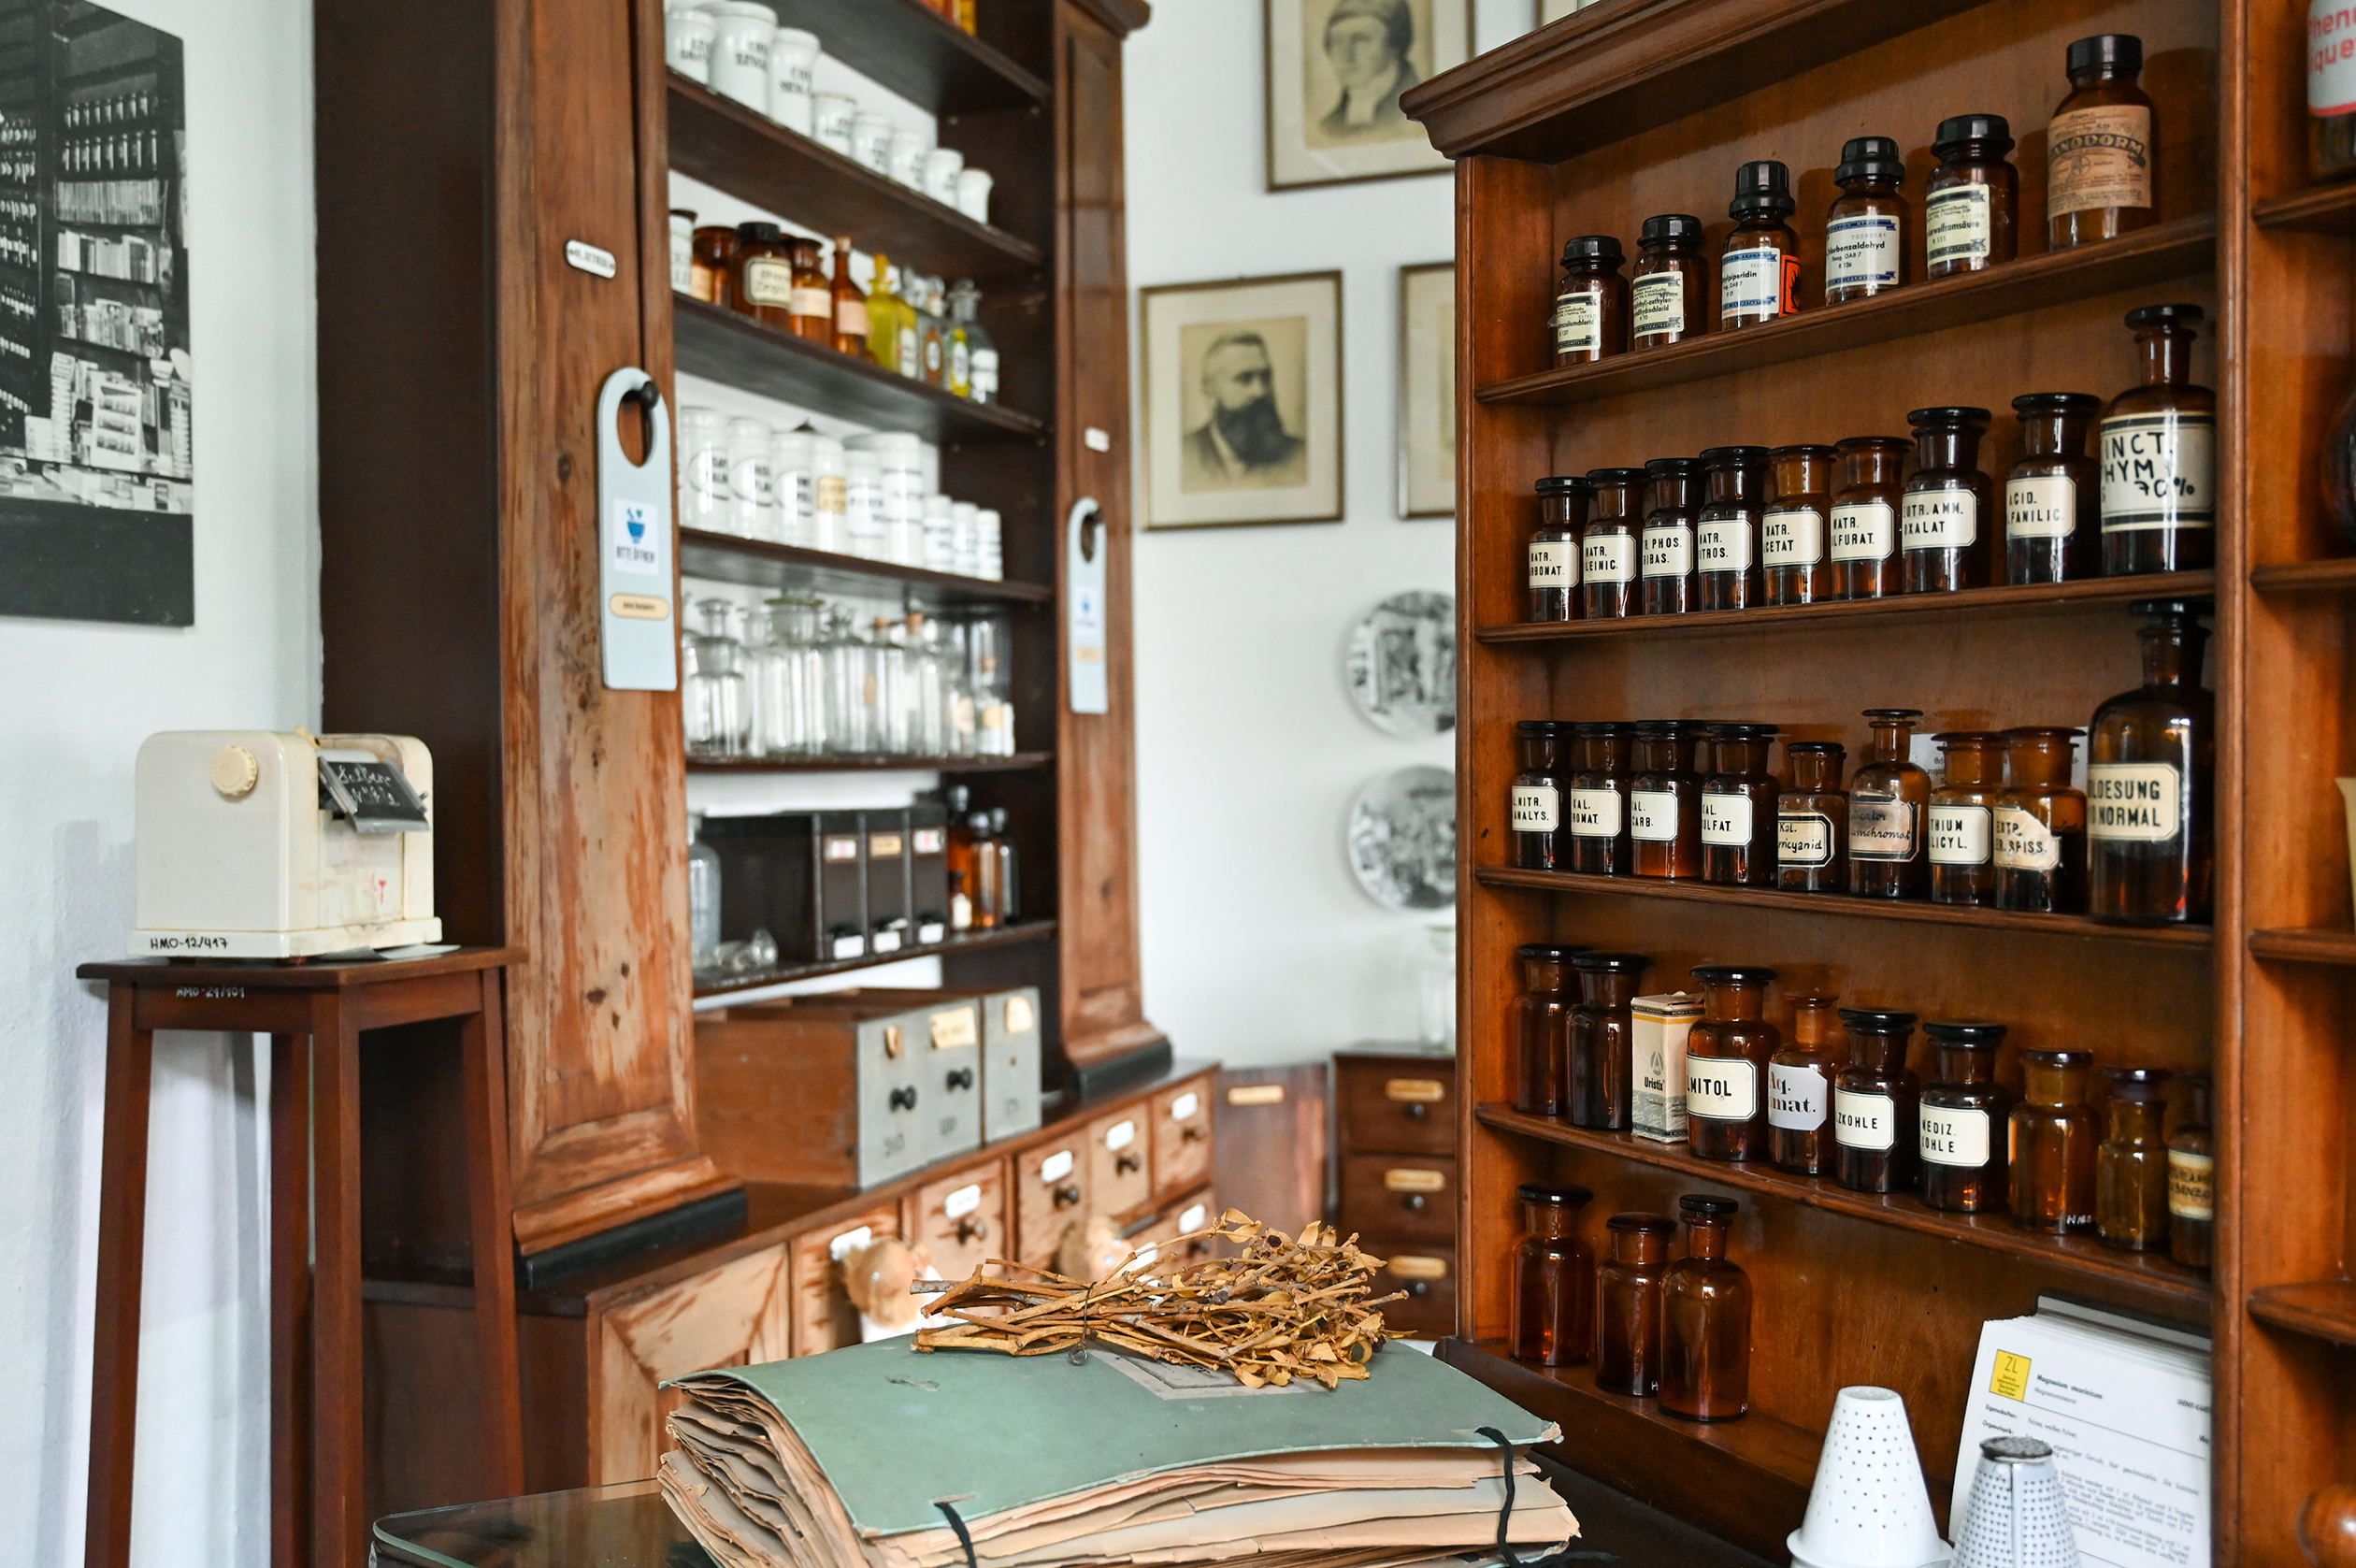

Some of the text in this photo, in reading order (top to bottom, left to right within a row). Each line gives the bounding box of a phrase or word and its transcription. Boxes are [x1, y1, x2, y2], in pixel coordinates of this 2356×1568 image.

[2007, 508, 2064, 525] FANILIC.
[1644, 1076, 1663, 1091] Uristix
[1835, 1112, 1878, 1129] ZKOHLE
[2004, 1355, 2017, 1374] ZL
